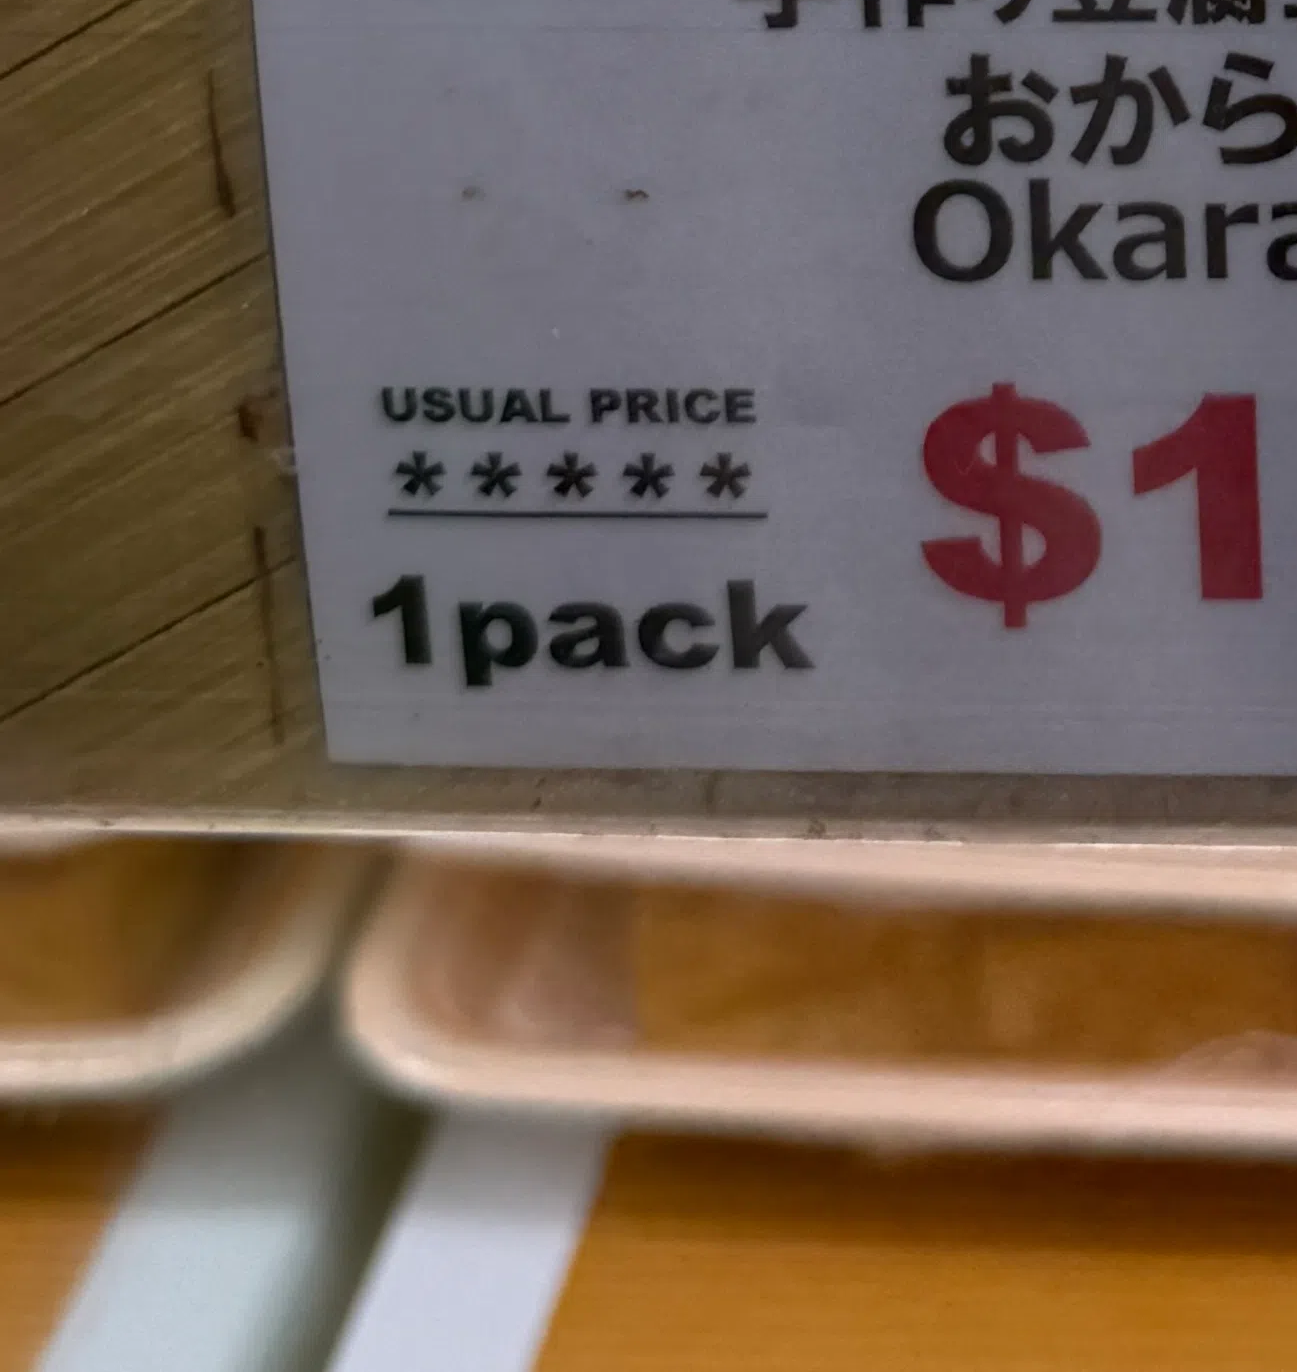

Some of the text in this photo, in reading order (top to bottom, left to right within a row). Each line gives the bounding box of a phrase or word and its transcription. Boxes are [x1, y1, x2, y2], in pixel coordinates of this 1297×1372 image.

[379, 386, 757, 427] USUAL PRICE
[370, 574, 814, 690] 1pack
